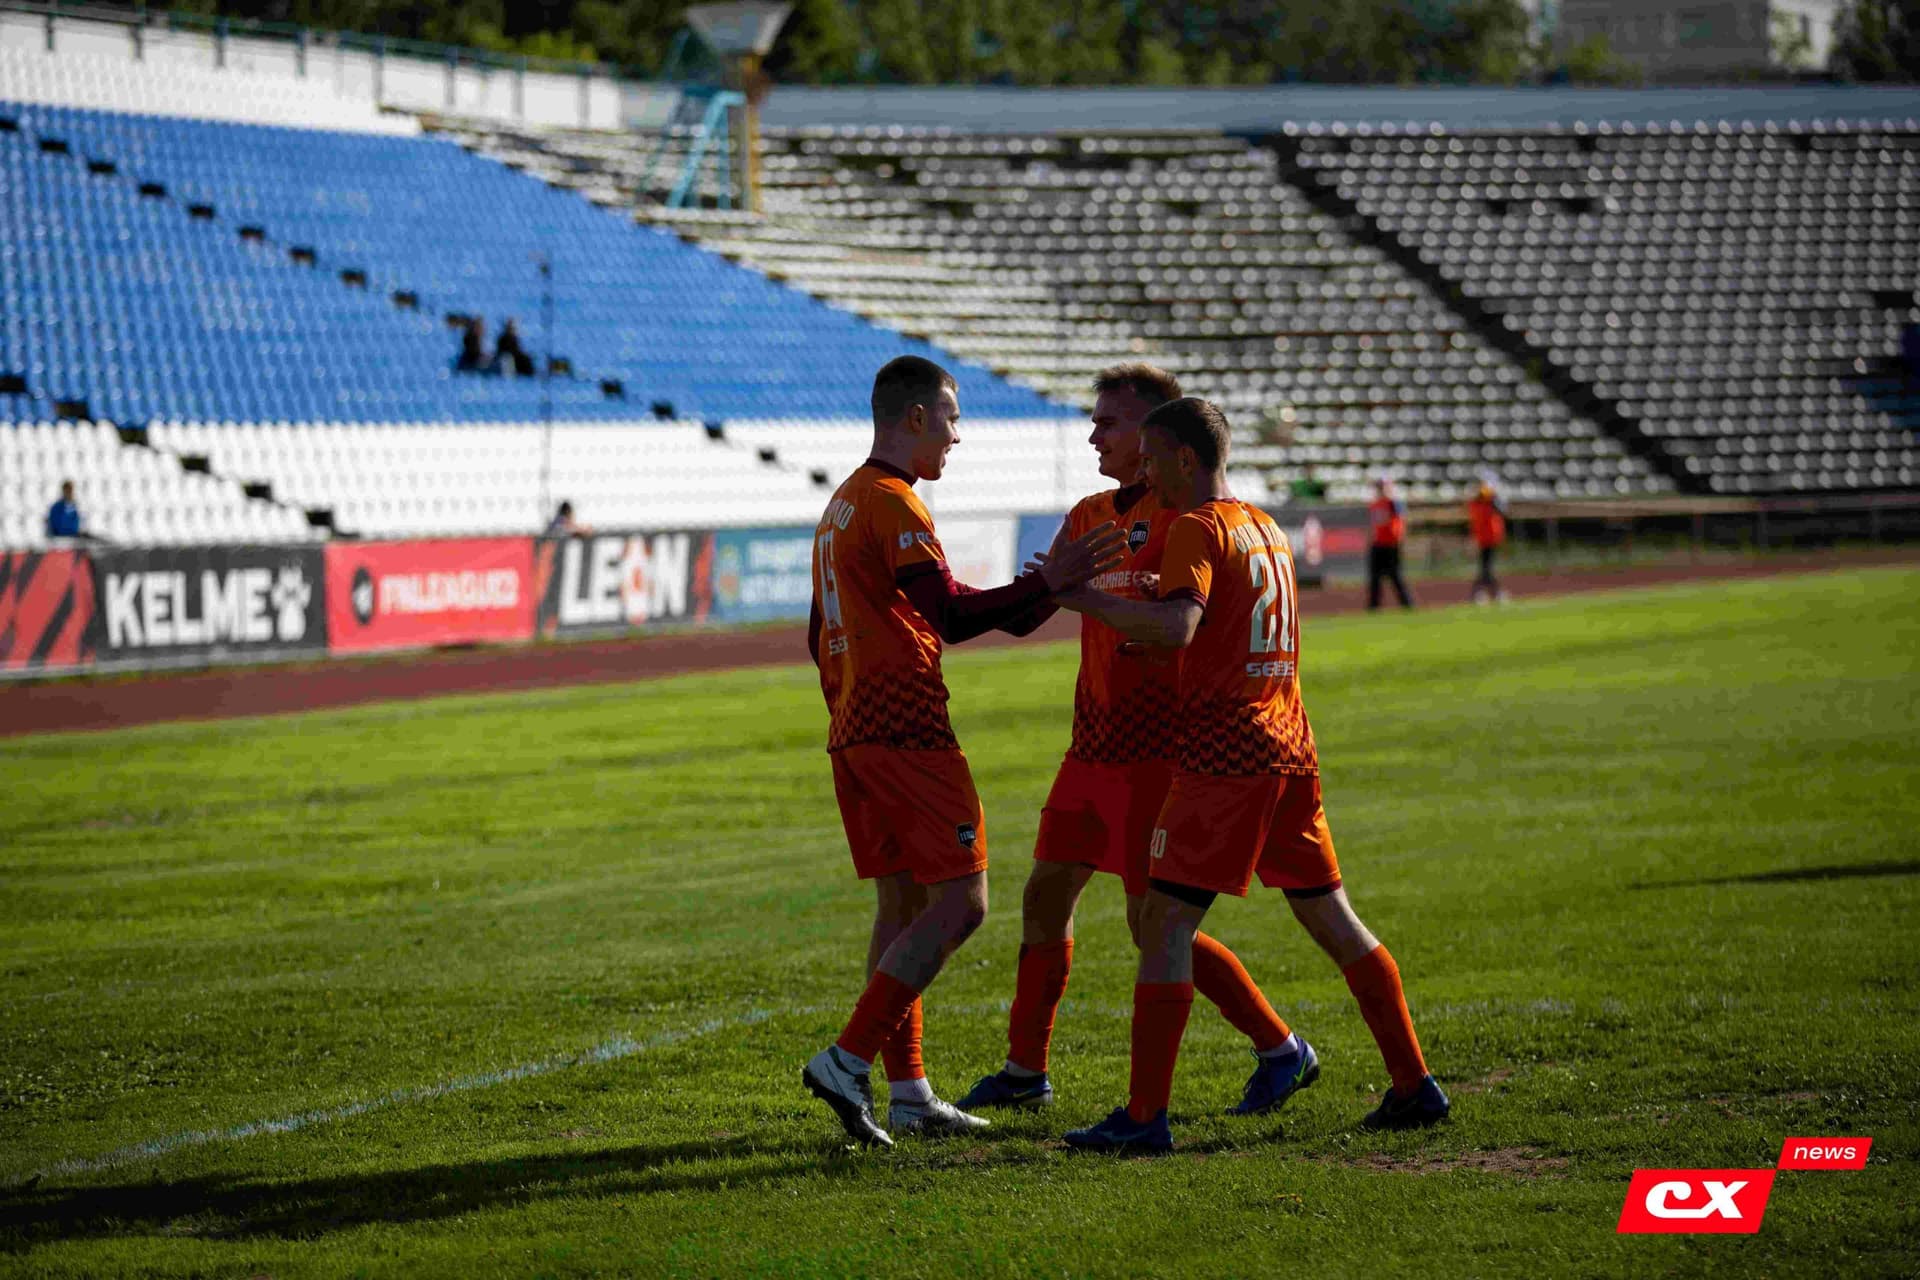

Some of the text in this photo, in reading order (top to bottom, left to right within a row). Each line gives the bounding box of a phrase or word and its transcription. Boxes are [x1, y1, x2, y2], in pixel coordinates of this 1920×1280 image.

[105, 568, 273, 648] KELME
[560, 532, 690, 625] LEON
[1249, 552, 1295, 653] 20
